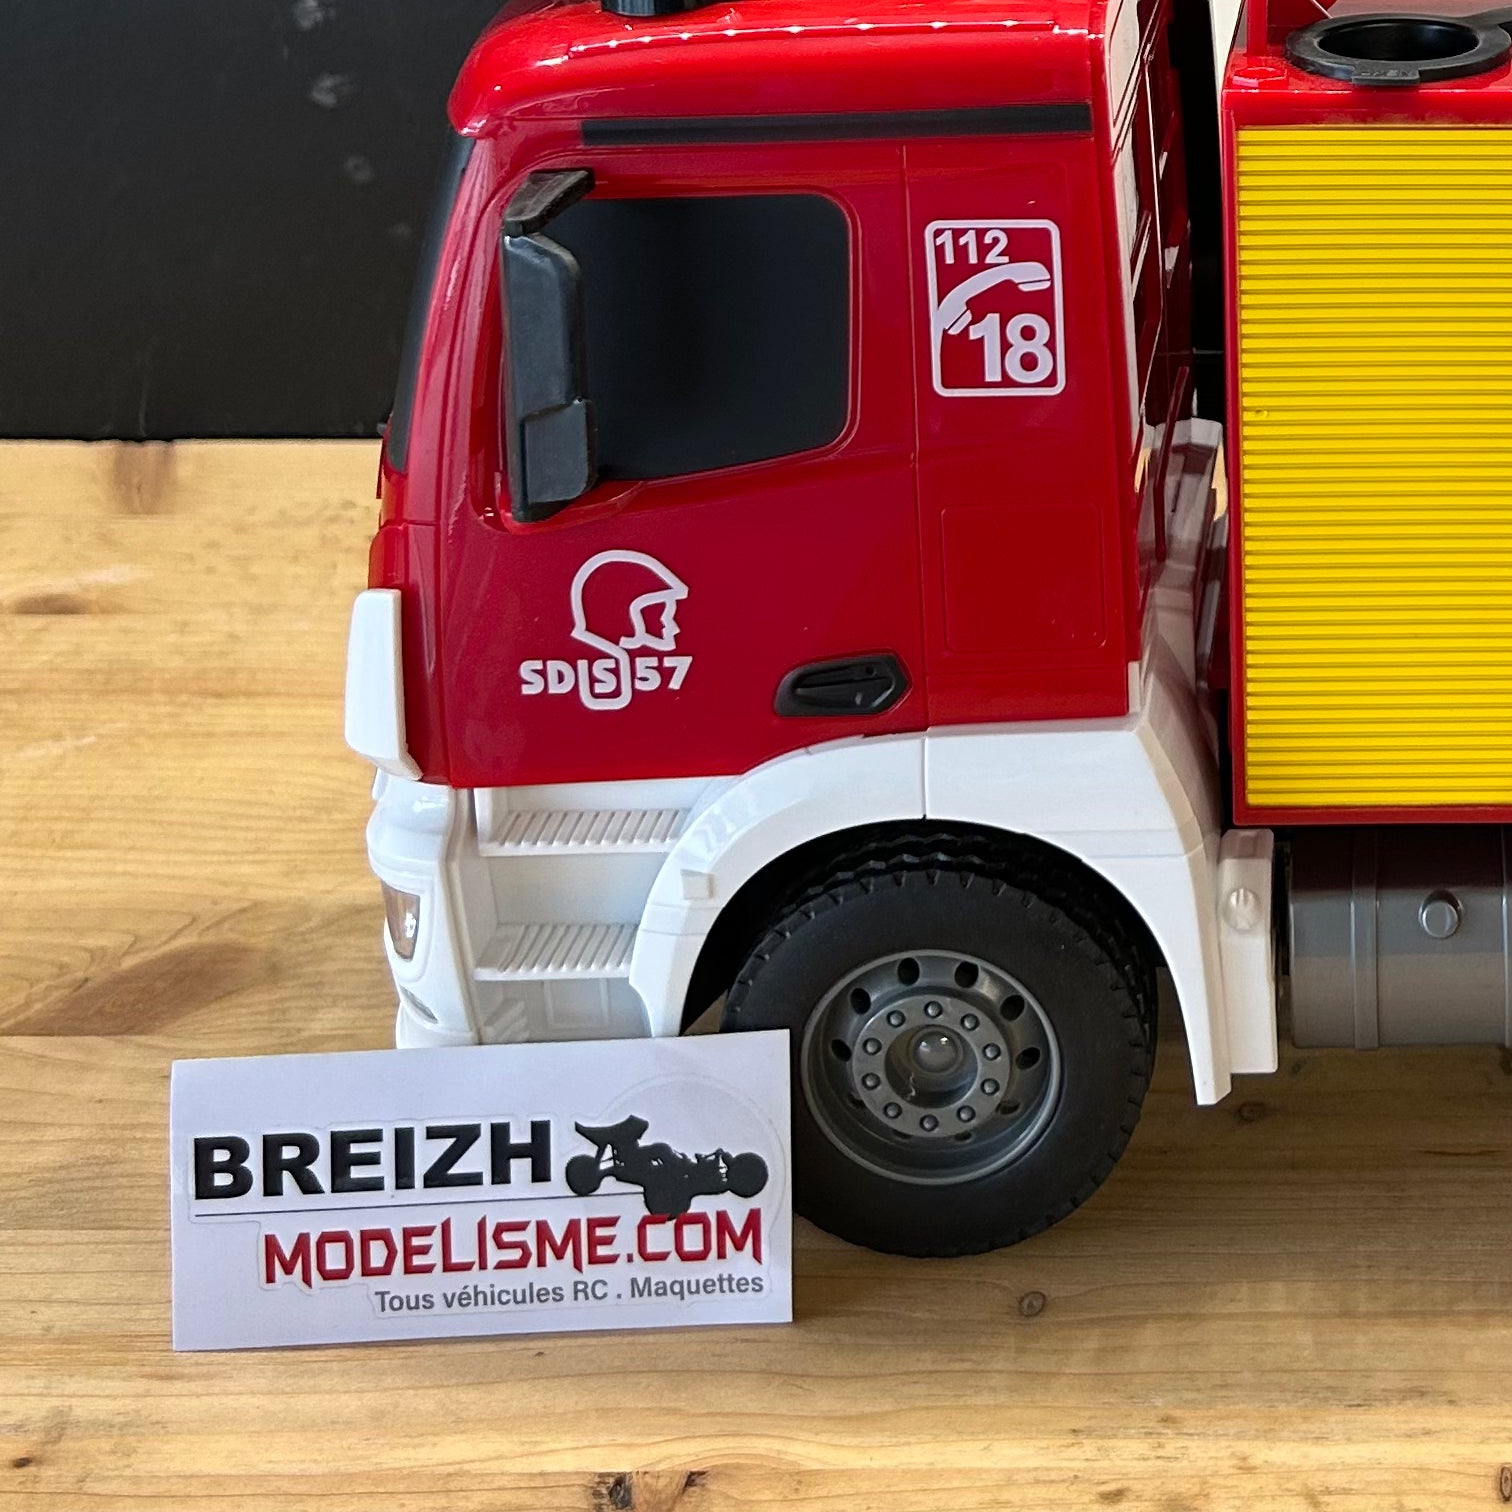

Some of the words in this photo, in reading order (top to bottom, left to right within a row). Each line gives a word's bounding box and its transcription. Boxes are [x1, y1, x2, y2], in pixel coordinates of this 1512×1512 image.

[935, 229, 1010, 264] 112
[969, 312, 1054, 384] 18
[193, 1119, 553, 1201] BREIZH
[264, 1208, 763, 1289] MODELISME.COM
[375, 1290, 435, 1313] Tous
[443, 1281, 565, 1309] véhicules
[573, 1278, 609, 1302] RC
[630, 1273, 764, 1301] Maquettes
